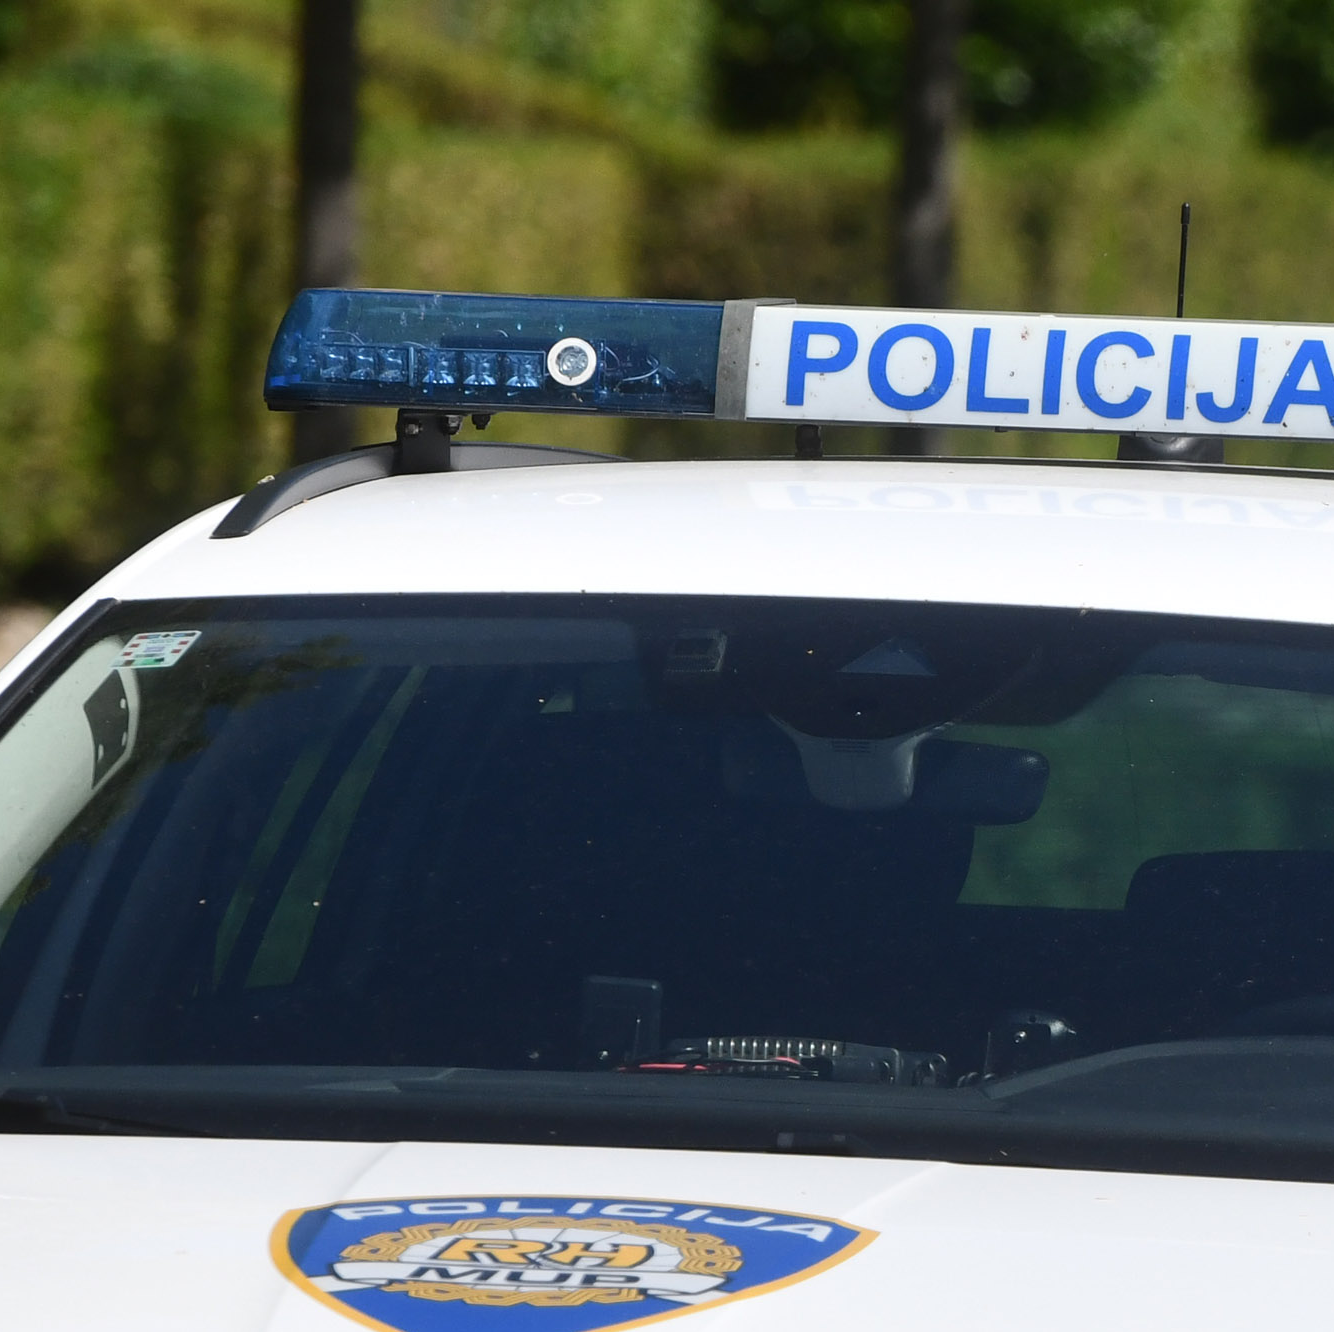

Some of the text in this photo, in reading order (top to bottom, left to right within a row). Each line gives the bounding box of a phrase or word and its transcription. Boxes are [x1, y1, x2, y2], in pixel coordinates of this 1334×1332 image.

[331, 1201, 833, 1243] POLICIJA
[433, 1236, 655, 1270] RH
[408, 1265, 641, 1287] MUP
